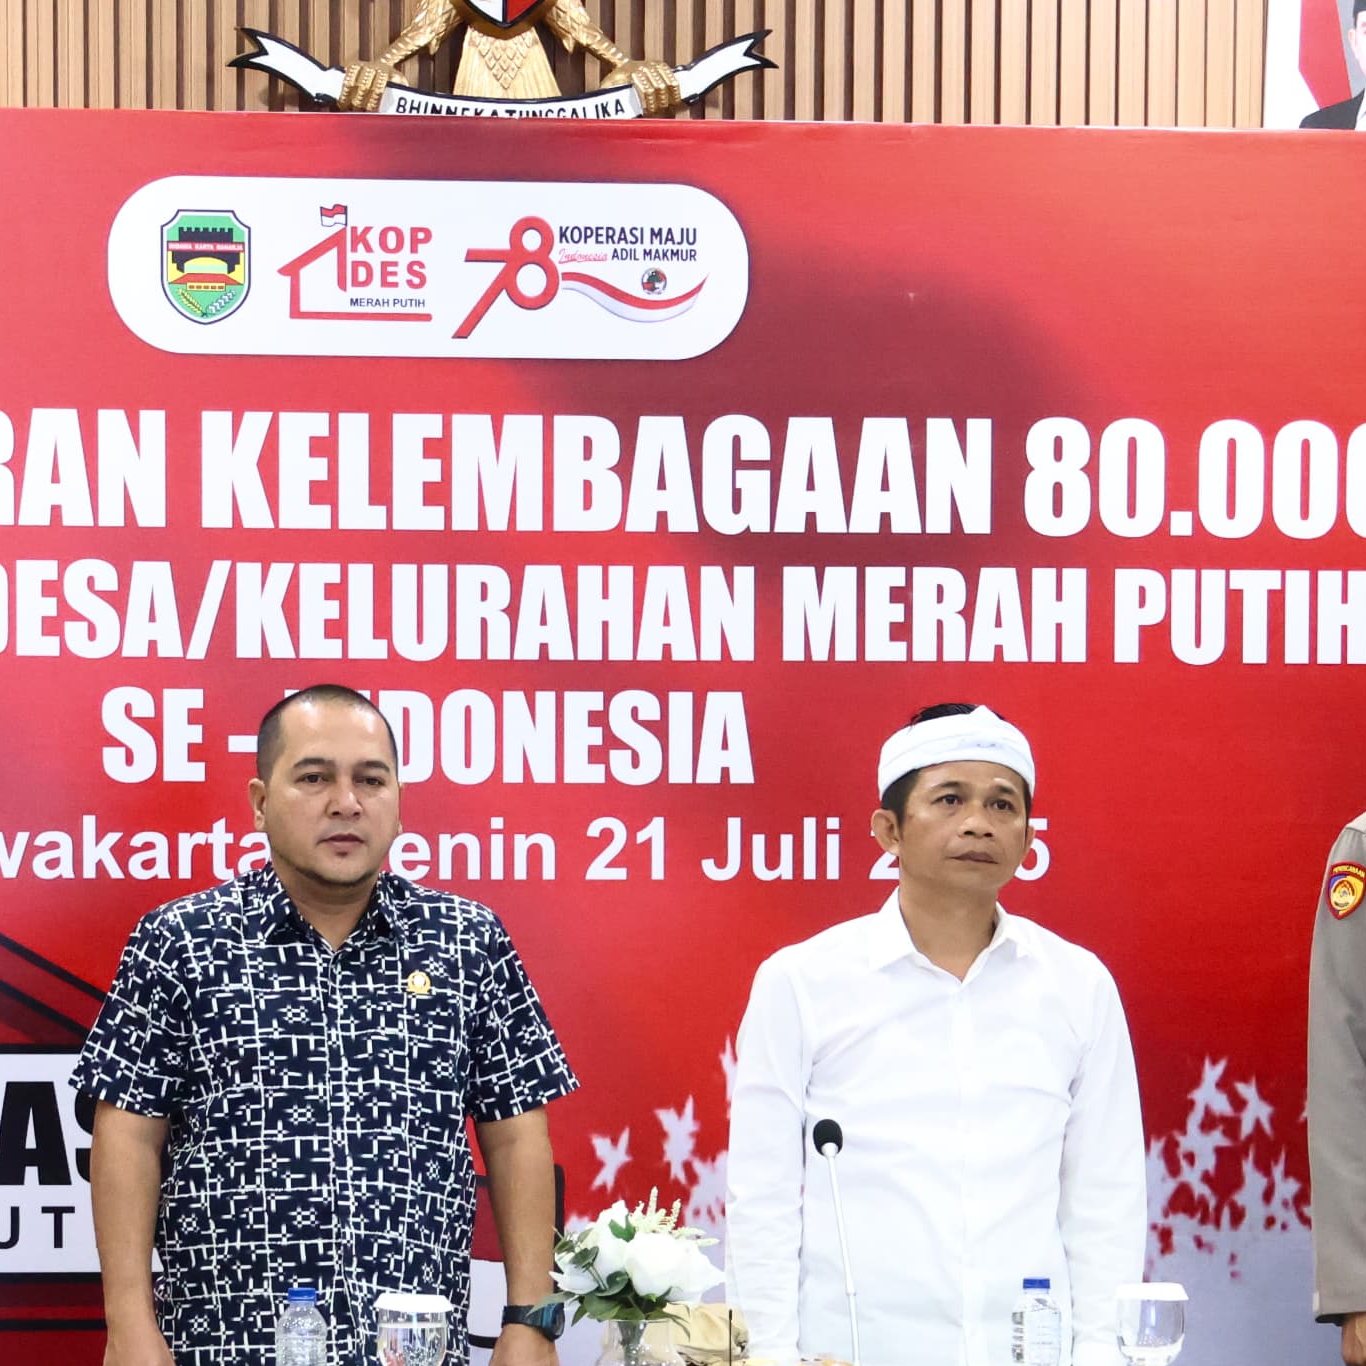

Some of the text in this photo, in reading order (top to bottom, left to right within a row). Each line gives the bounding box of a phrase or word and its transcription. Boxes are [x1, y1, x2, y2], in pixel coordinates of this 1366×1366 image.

[595, 99, 625, 119] IKA
[351, 226, 432, 254] KOP
[559, 226, 697, 246] KOPERASI MAJU
[611, 247, 639, 261] ADIL
[643, 248, 697, 262] MAKMUR
[352, 261, 427, 289] DES
[451, 216, 559, 339] 78
[350, 298, 425, 308] MERAH PUTIH
[201, 411, 991, 536] KELEMBAGAAN
[782, 567, 1087, 663] MERAH
[101, 686, 206, 784] SE
[284, 689, 755, 786] DONESIA
[389, 817, 556, 881] enin
[586, 817, 665, 881] 21
[701, 817, 840, 881] Juli
